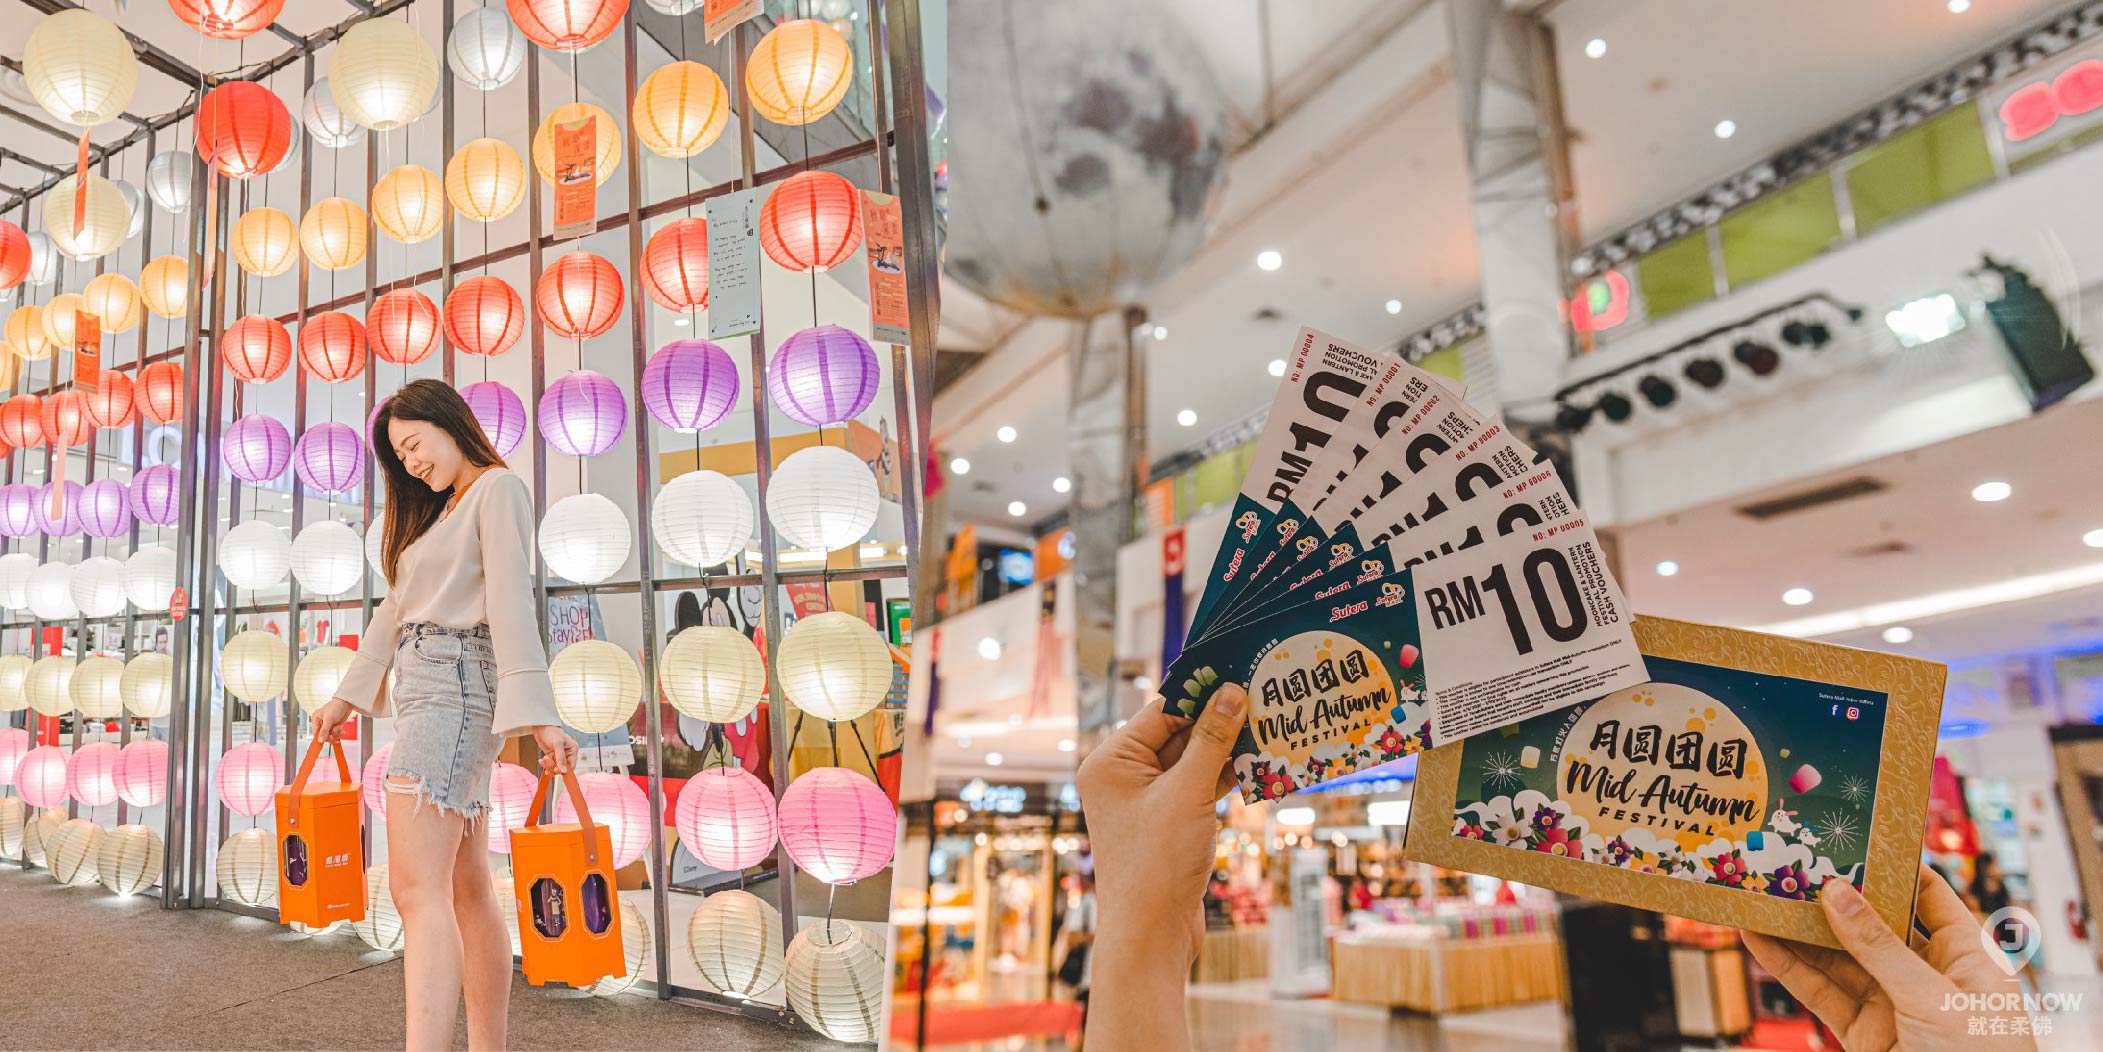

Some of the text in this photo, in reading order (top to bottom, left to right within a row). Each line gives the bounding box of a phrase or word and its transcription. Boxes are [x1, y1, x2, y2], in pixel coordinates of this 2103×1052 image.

[1296, 358, 1306, 369] MP
[1322, 358, 1354, 375] LANTERN
[1325, 351, 1369, 372] PROMOTION
[1328, 343, 1377, 367] VOUCHERS
[1375, 383, 1385, 395] MP
[1411, 413, 1421, 425] MP
[1455, 450, 1469, 461] NO:
[1467, 441, 1478, 452] MP
[1503, 489, 1516, 499] NO:
[1516, 481, 1527, 492] MP
[1532, 532, 1547, 542] NO:
[1547, 527, 1558, 537] MP
[1223, 548, 1245, 582] Sutera
[1568, 547, 1584, 578] LANTERN
[1576, 544, 1610, 626] FESTIVAL PROMOTION
[1583, 541, 1619, 623] CASH VOUCHERS
[549, 603, 589, 628] SHOP
[1329, 600, 1369, 623] Sutera
[1424, 548, 1588, 656] RM10
[1583, 585, 1603, 627] MOONCAKE
[1257, 704, 1308, 746] Mid
[1309, 687, 1392, 730] Autumn
[1290, 718, 1371, 751] FESTIVAL
[1589, 719, 1748, 779] 月圆团圆
[1566, 759, 1761, 826] Mid Autumn
[1598, 806, 1715, 837] FESTIVAL
